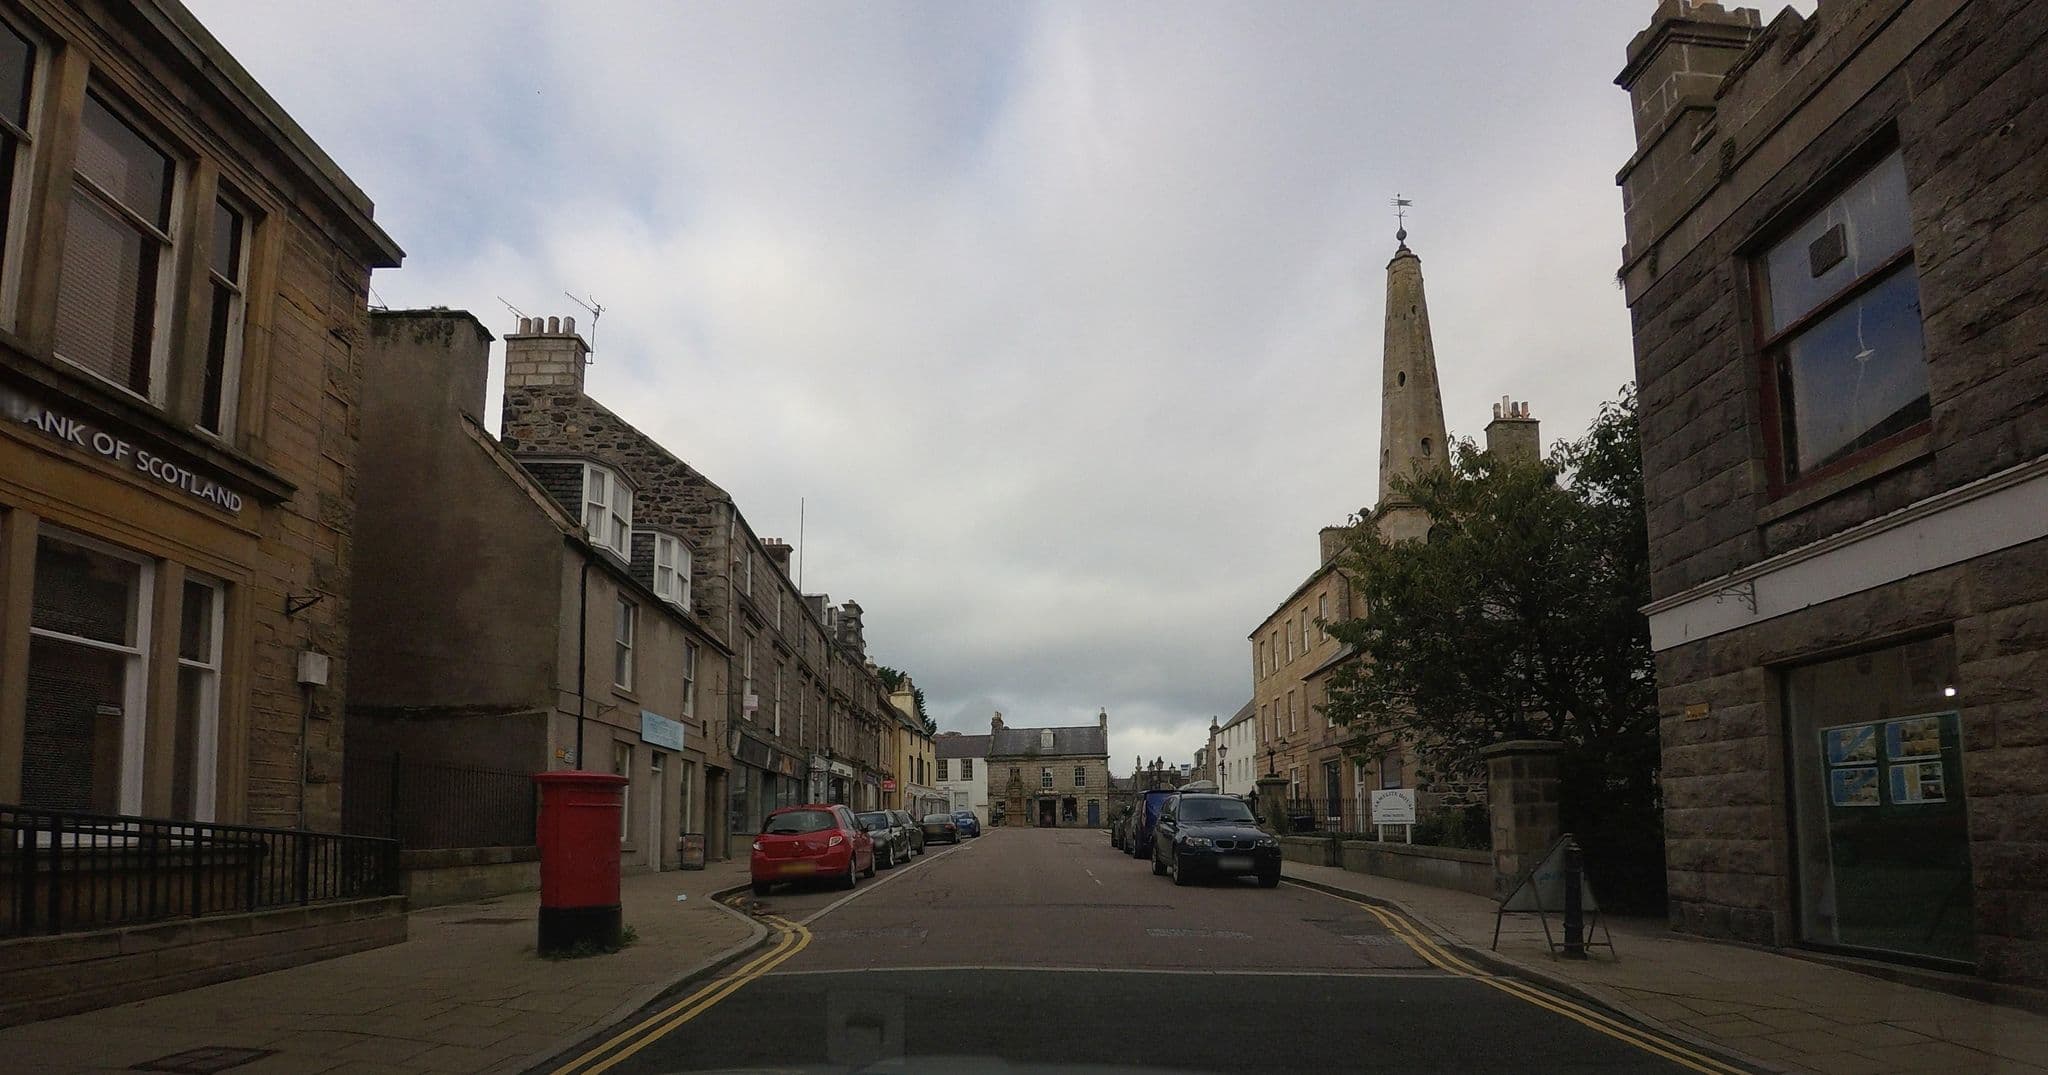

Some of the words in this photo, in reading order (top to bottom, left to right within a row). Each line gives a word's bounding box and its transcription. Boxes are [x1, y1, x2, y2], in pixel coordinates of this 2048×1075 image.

[12, 402, 86, 446] ANK
[92, 432, 130, 460] OF
[136, 450, 242, 512] SCOTLAND
